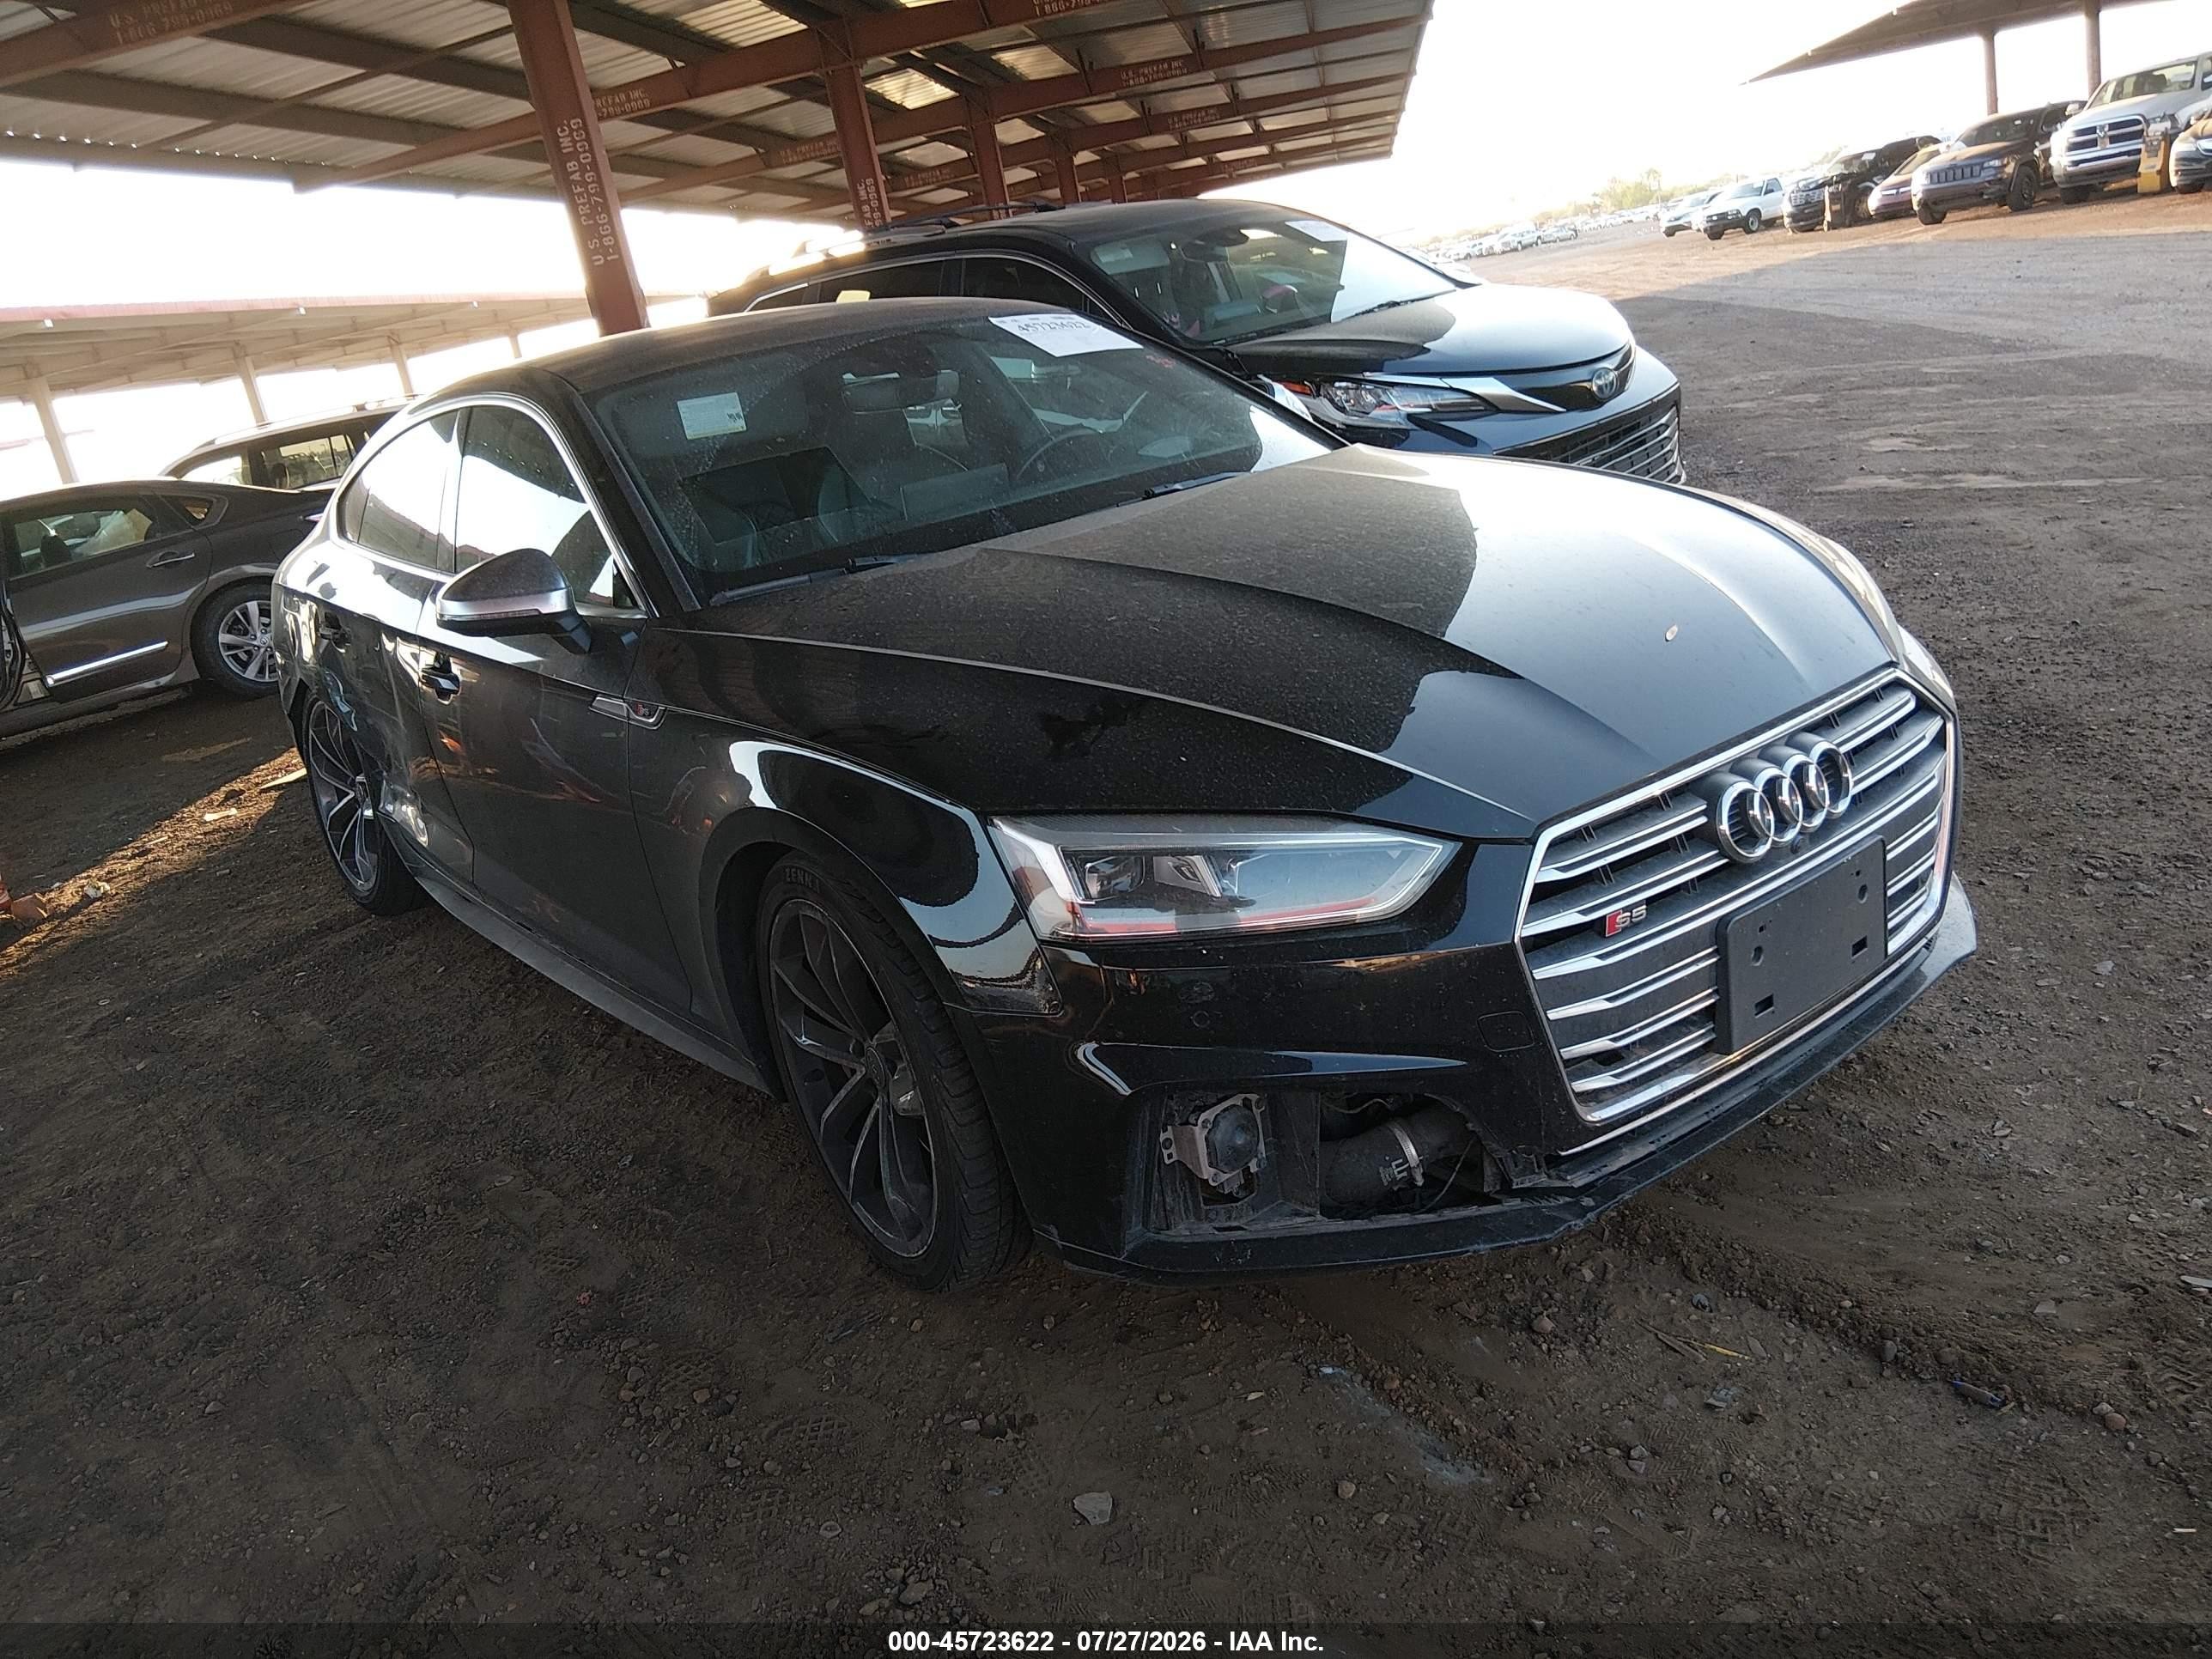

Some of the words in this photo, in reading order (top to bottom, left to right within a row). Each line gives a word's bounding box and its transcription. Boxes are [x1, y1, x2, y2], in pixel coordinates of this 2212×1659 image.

[557, 120, 574, 153] INC.
[567, 161, 594, 225] PREFAB
[588, 234, 605, 265] U.S.
[1614, 904, 1647, 928] S5
